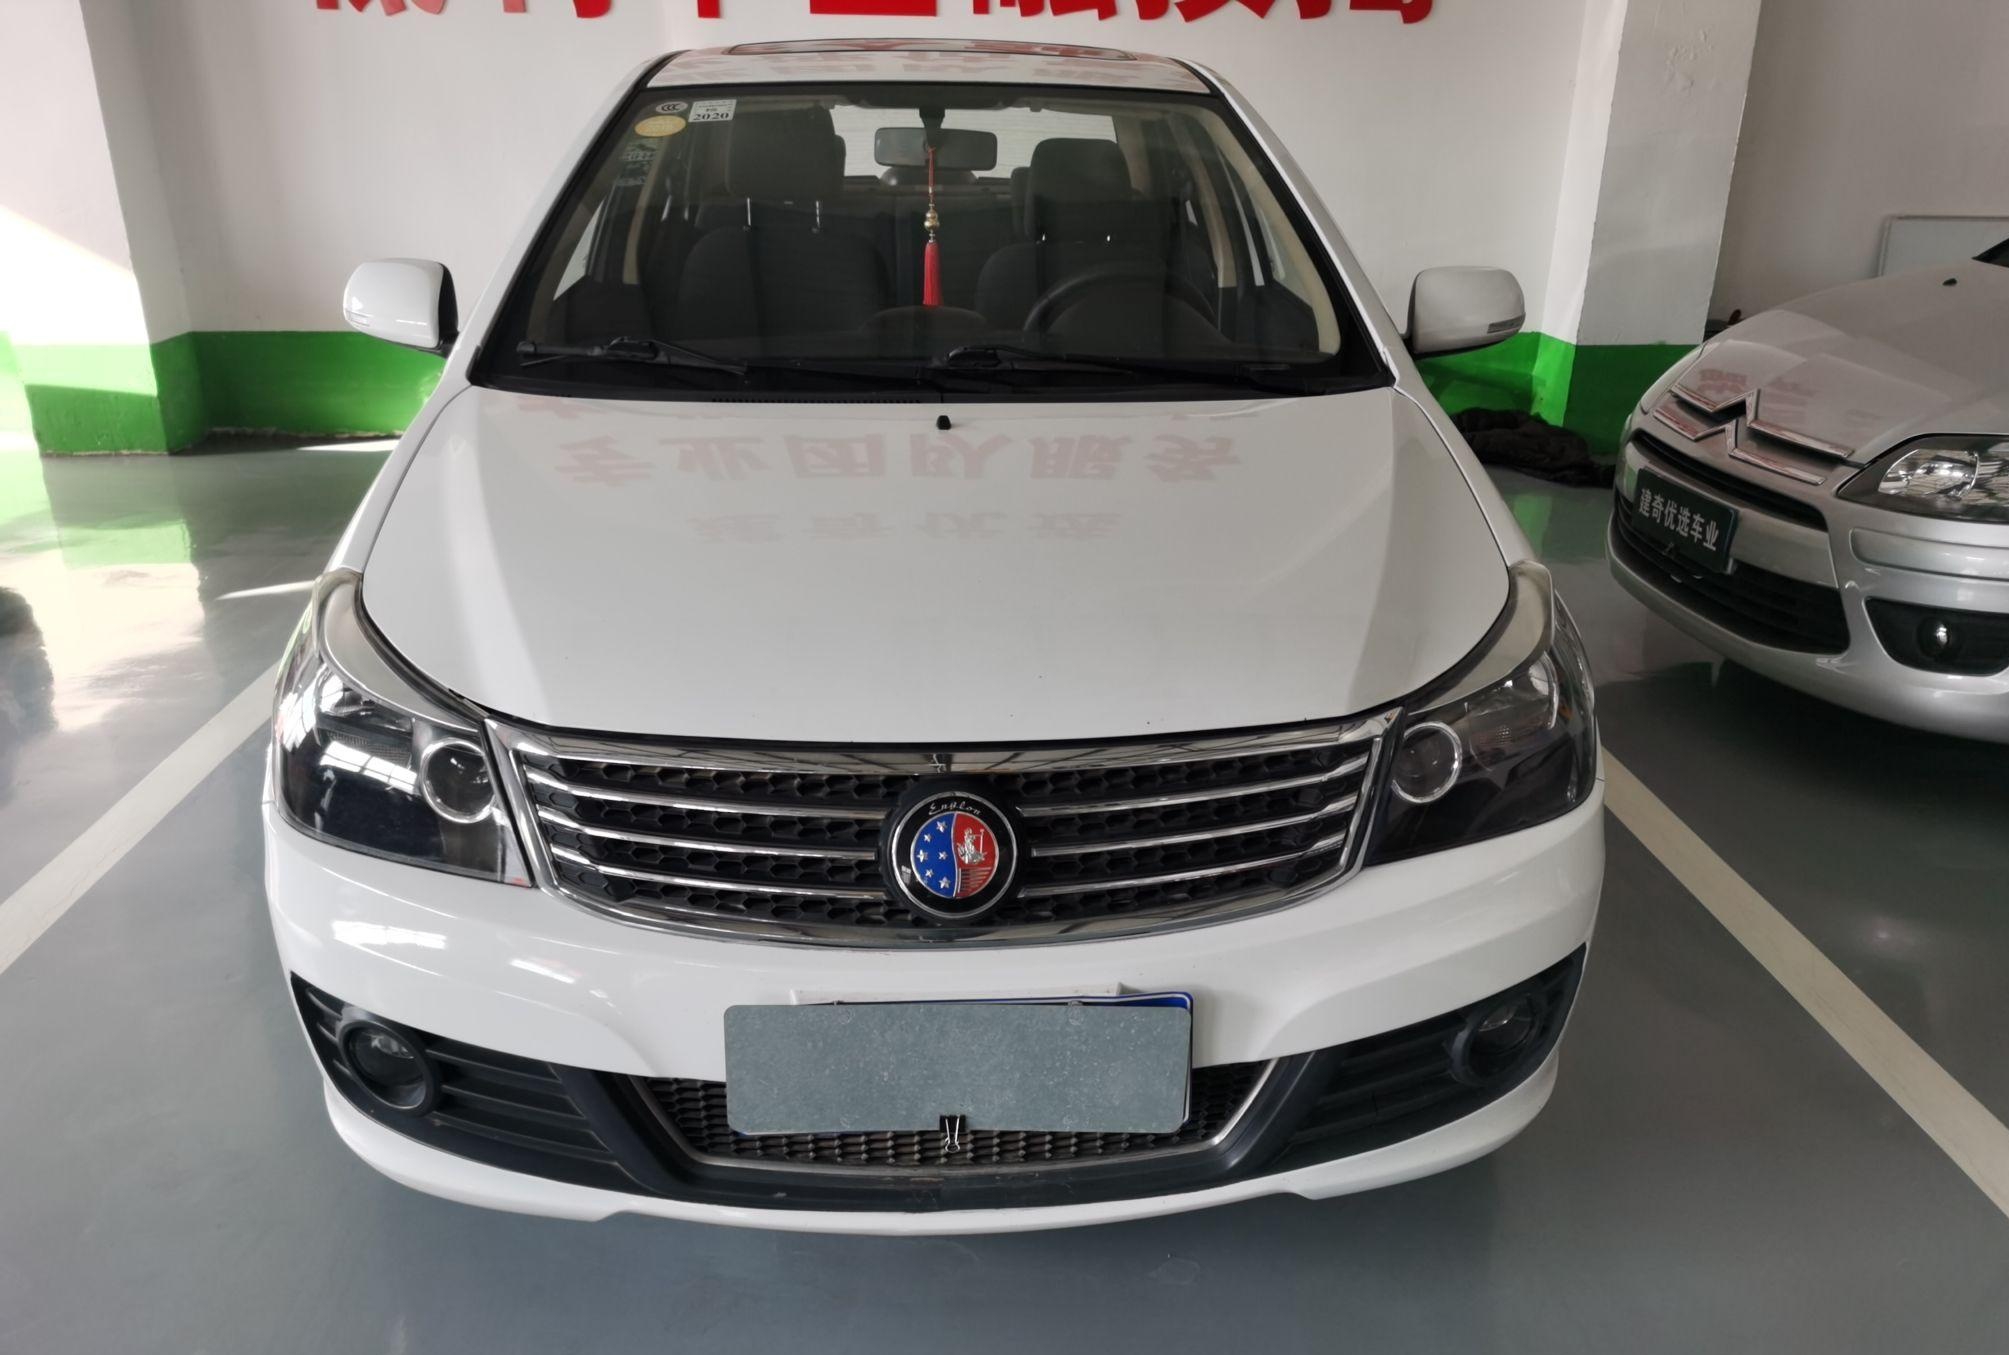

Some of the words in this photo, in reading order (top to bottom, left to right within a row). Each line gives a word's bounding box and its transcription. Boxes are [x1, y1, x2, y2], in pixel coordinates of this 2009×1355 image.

[693, 112, 730, 121] 2020
[1638, 487, 1719, 551] 建奇优选车业
